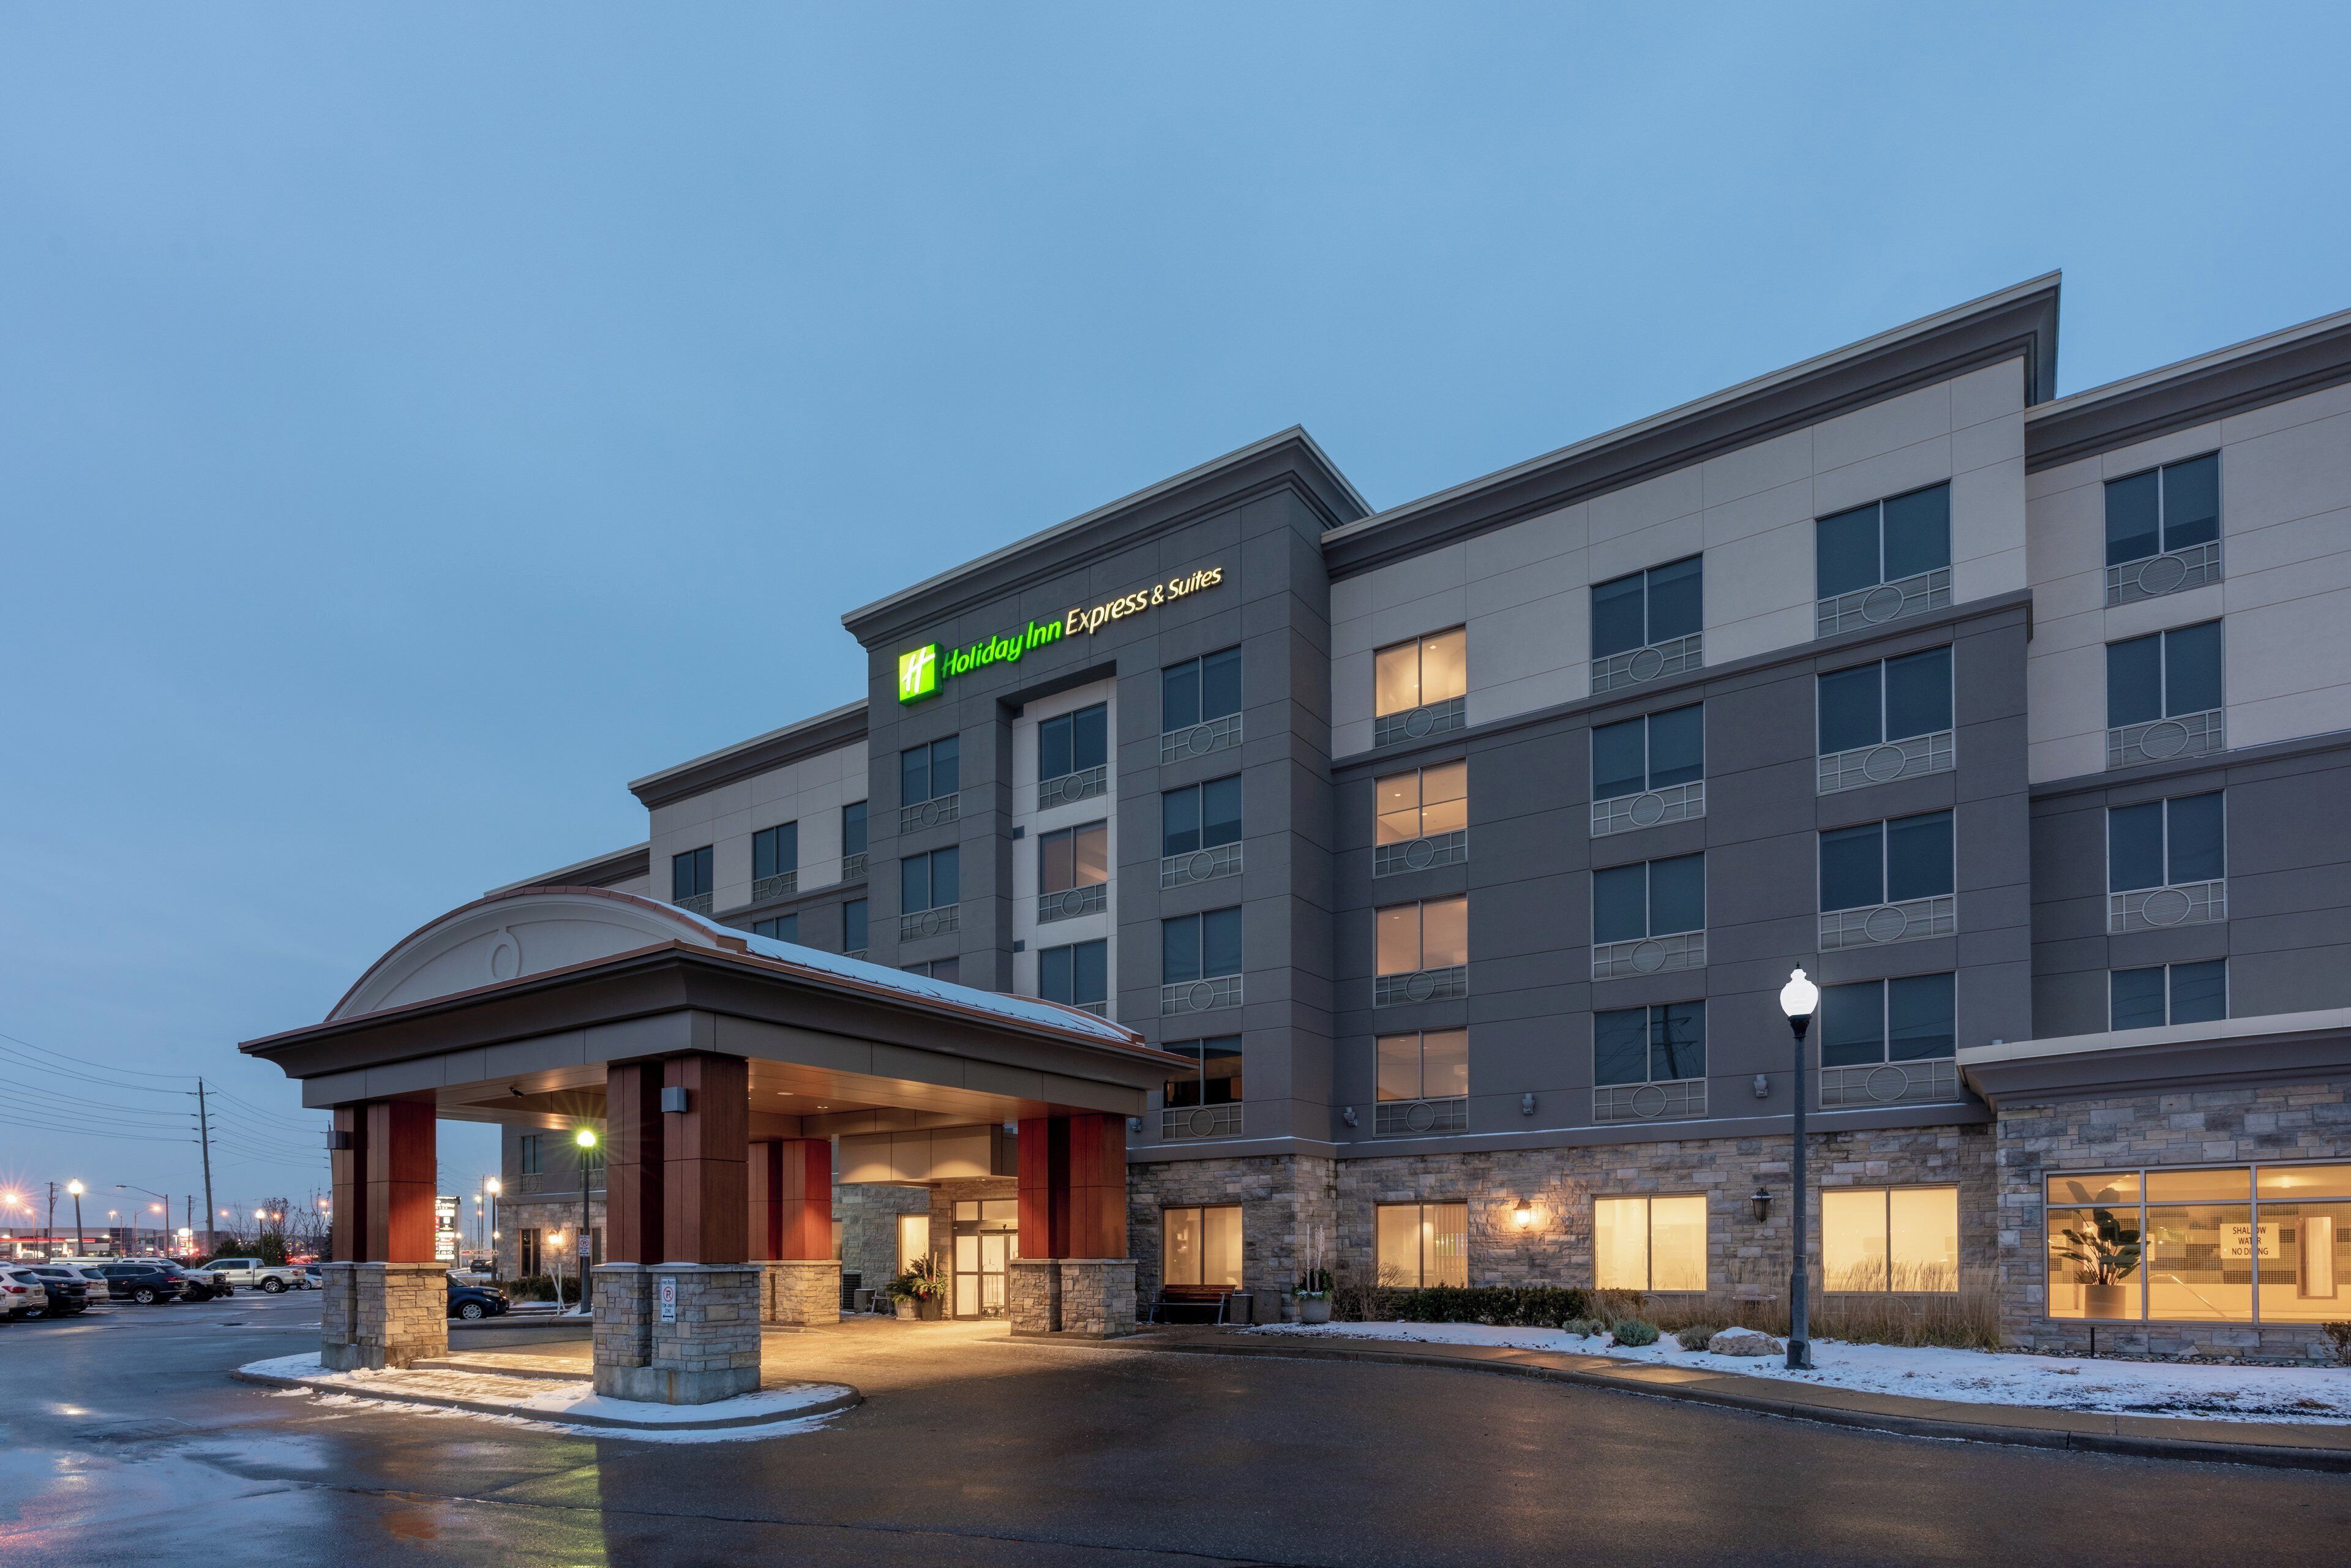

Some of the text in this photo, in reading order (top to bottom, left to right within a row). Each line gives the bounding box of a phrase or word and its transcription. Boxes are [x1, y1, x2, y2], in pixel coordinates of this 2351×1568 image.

[941, 634, 1024, 679] Holiday
[1026, 620, 1062, 650] Inn
[1065, 590, 1148, 636] Express
[1151, 584, 1164, 605] &
[1168, 567, 1222, 600] Suites
